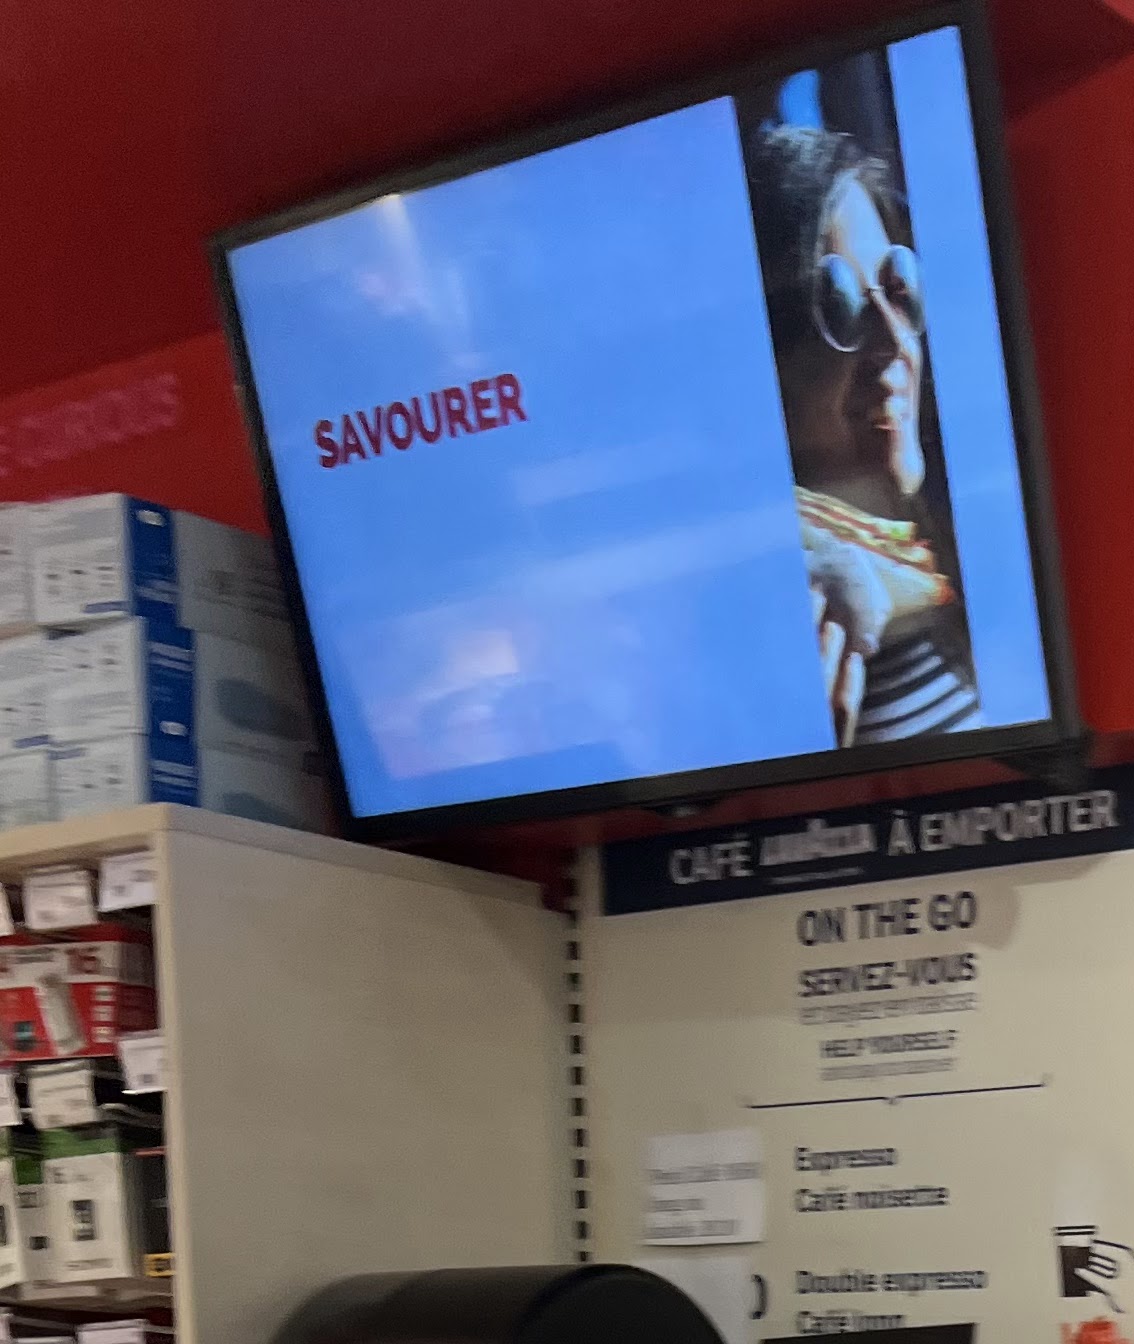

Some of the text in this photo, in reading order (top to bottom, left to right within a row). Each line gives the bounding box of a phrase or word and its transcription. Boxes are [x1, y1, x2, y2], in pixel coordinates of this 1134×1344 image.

[314, 372, 529, 469] SAVOURER
[918, 788, 1120, 852] EMPORTER
[797, 890, 978, 946] ON THE GO
[798, 952, 978, 998] SERVEZ-VOUS
